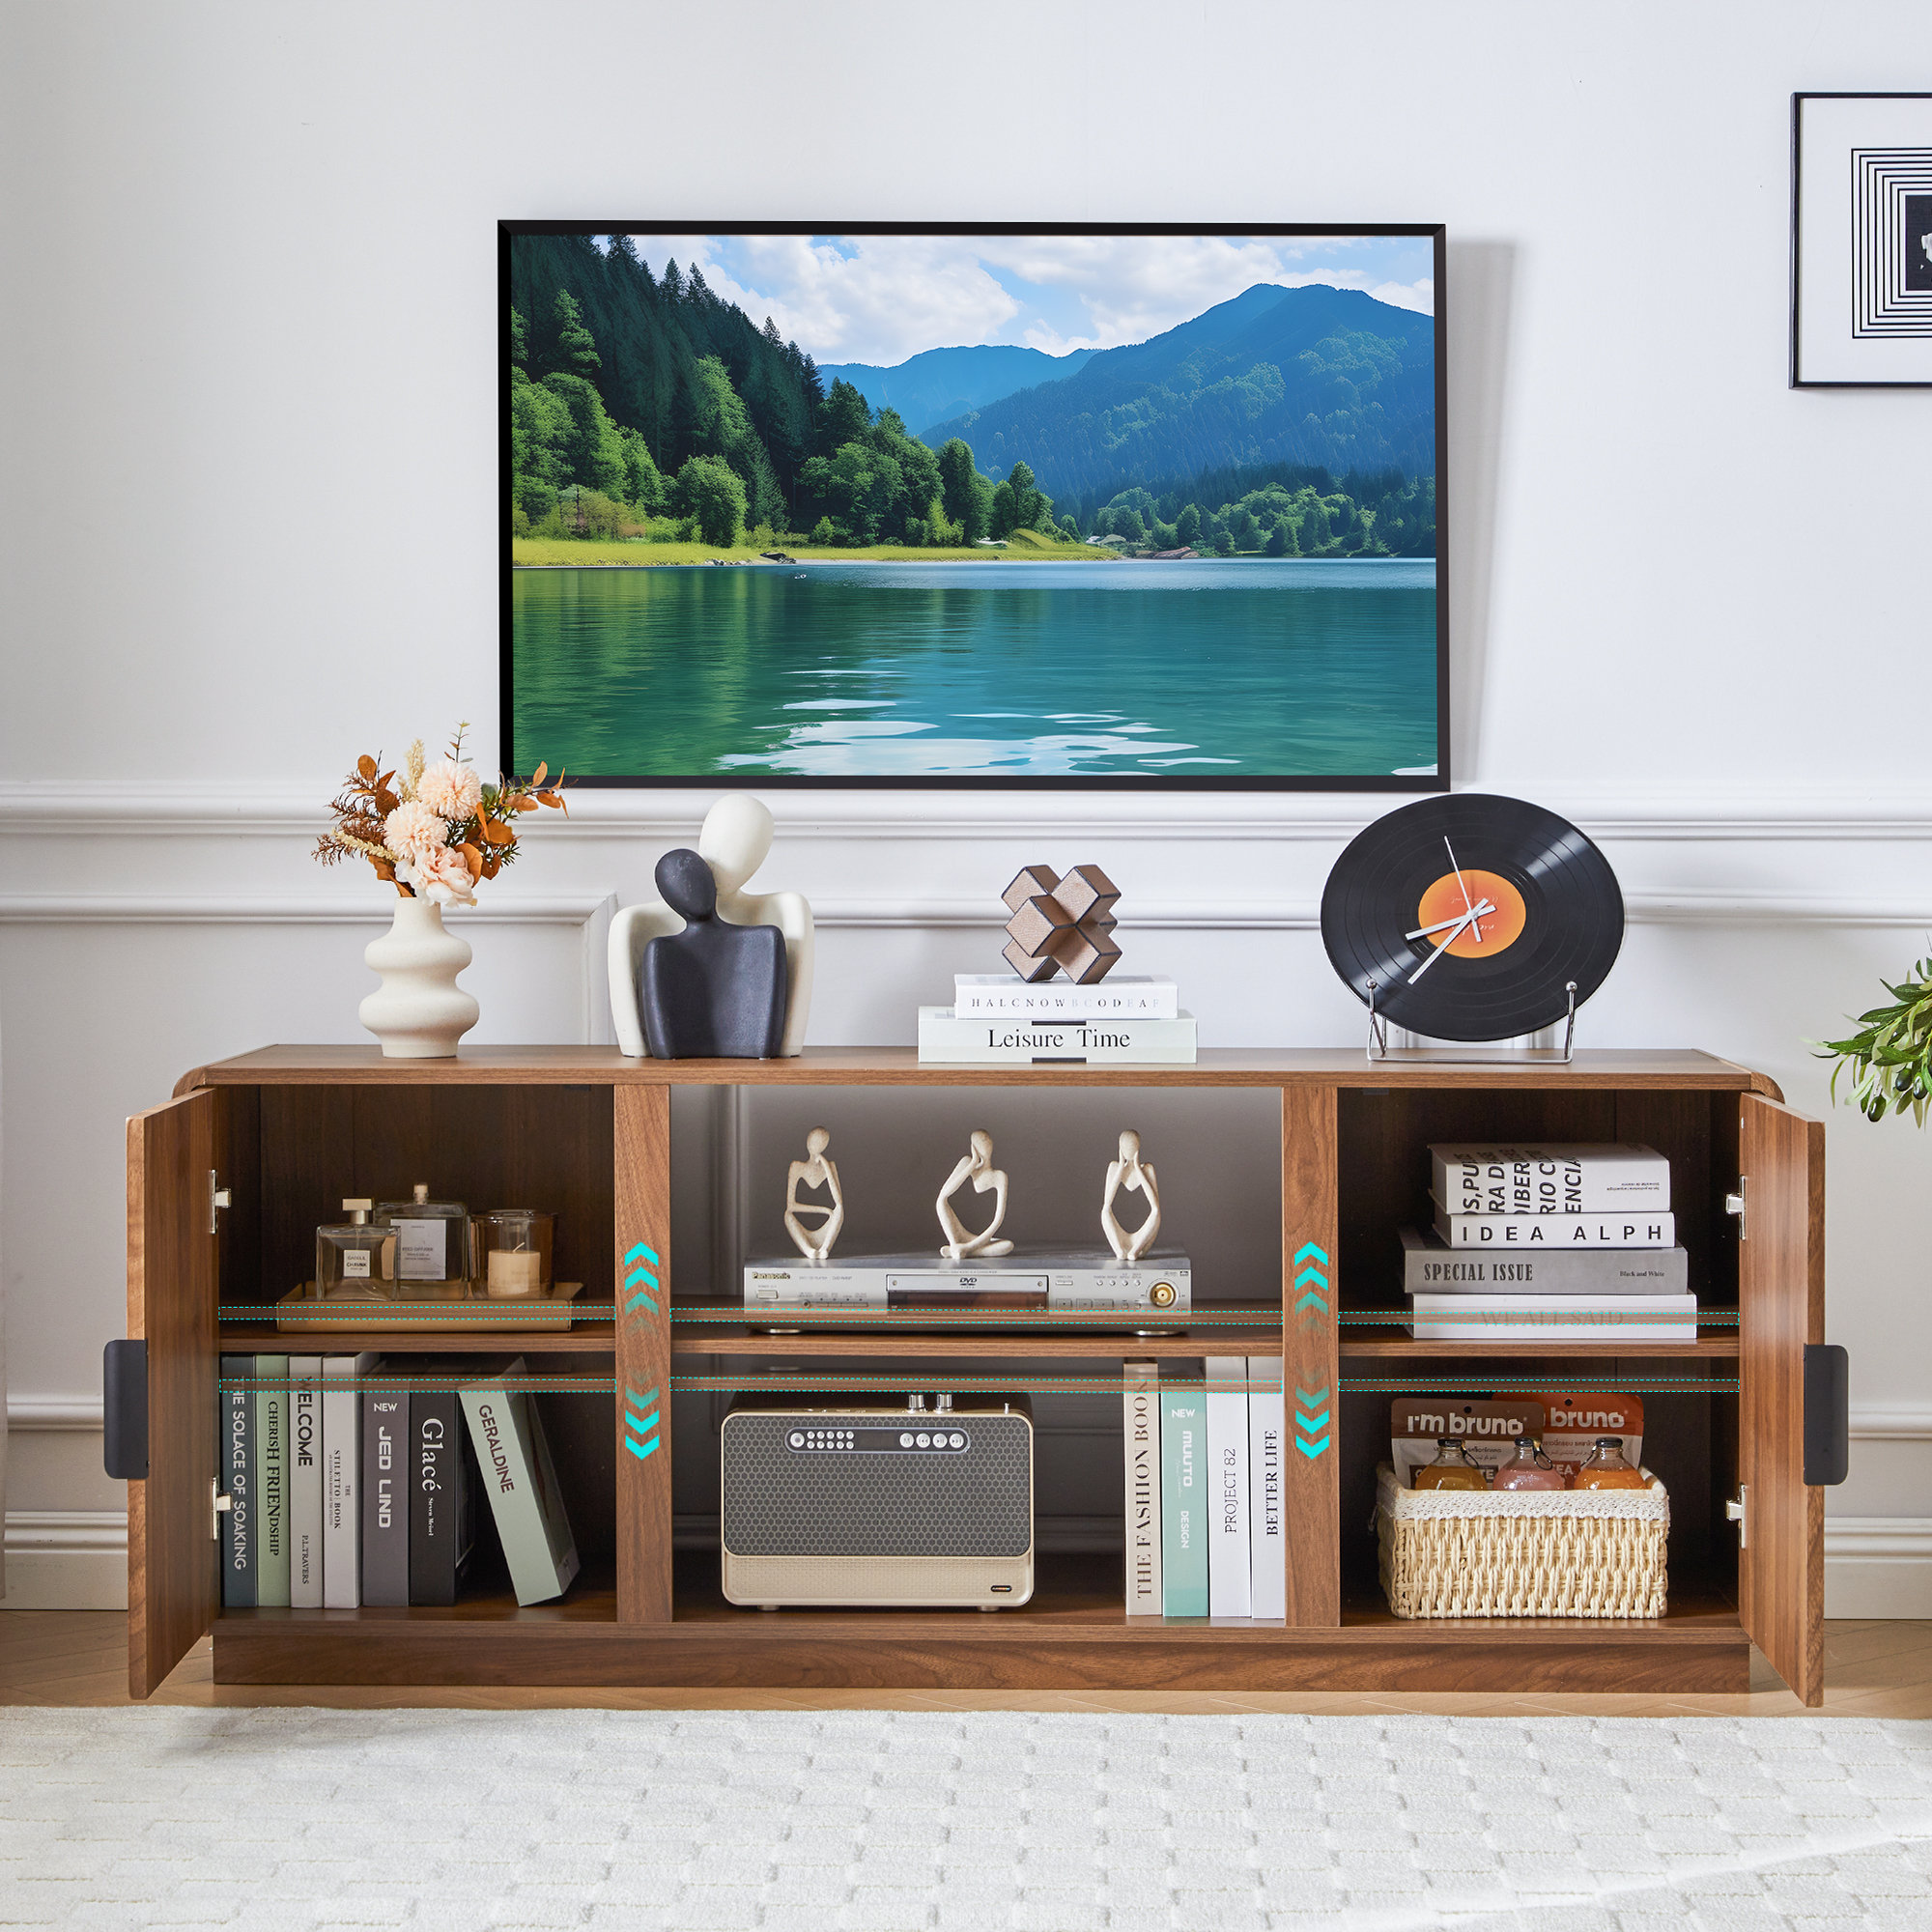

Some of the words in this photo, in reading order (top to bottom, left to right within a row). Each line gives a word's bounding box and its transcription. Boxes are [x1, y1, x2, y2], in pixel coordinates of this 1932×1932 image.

[987, 1028, 1065, 1049] Leisure
[1076, 1028, 1131, 1049] Time
[1463, 1226, 1545, 1241] IDEA
[1573, 1225, 1662, 1241] ALPH
[1424, 1263, 1486, 1282] SPECIAL
[1492, 1263, 1534, 1282] ISSUE
[297, 1376, 313, 1467] WELCOME
[373, 1403, 398, 1412] NEW
[1171, 1408, 1196, 1418] NEW
[1449, 1412, 1524, 1435] bruno
[1549, 1406, 1625, 1429] bruno
[232, 1410, 245, 1469] SOLACE
[267, 1401, 280, 1462] CHERISH
[378, 1426, 392, 1470] JED
[478, 1404, 516, 1494] GERALDINE
[1264, 1430, 1277, 1468] LIFE
[421, 1417, 444, 1492] Glacé
[1224, 1448, 1236, 1466] 82
[233, 1474, 246, 1495] OF
[378, 1479, 392, 1529] LIND
[1134, 1448, 1151, 1548] FASHION
[1224, 1469, 1238, 1534] PROJECT
[1265, 1471, 1279, 1536] BETTER
[267, 1465, 281, 1557] FRIENDSHIP
[1180, 1510, 1190, 1548] DESIGN
[233, 1501, 247, 1571] SOAKING
[1136, 1553, 1152, 1599] THE
